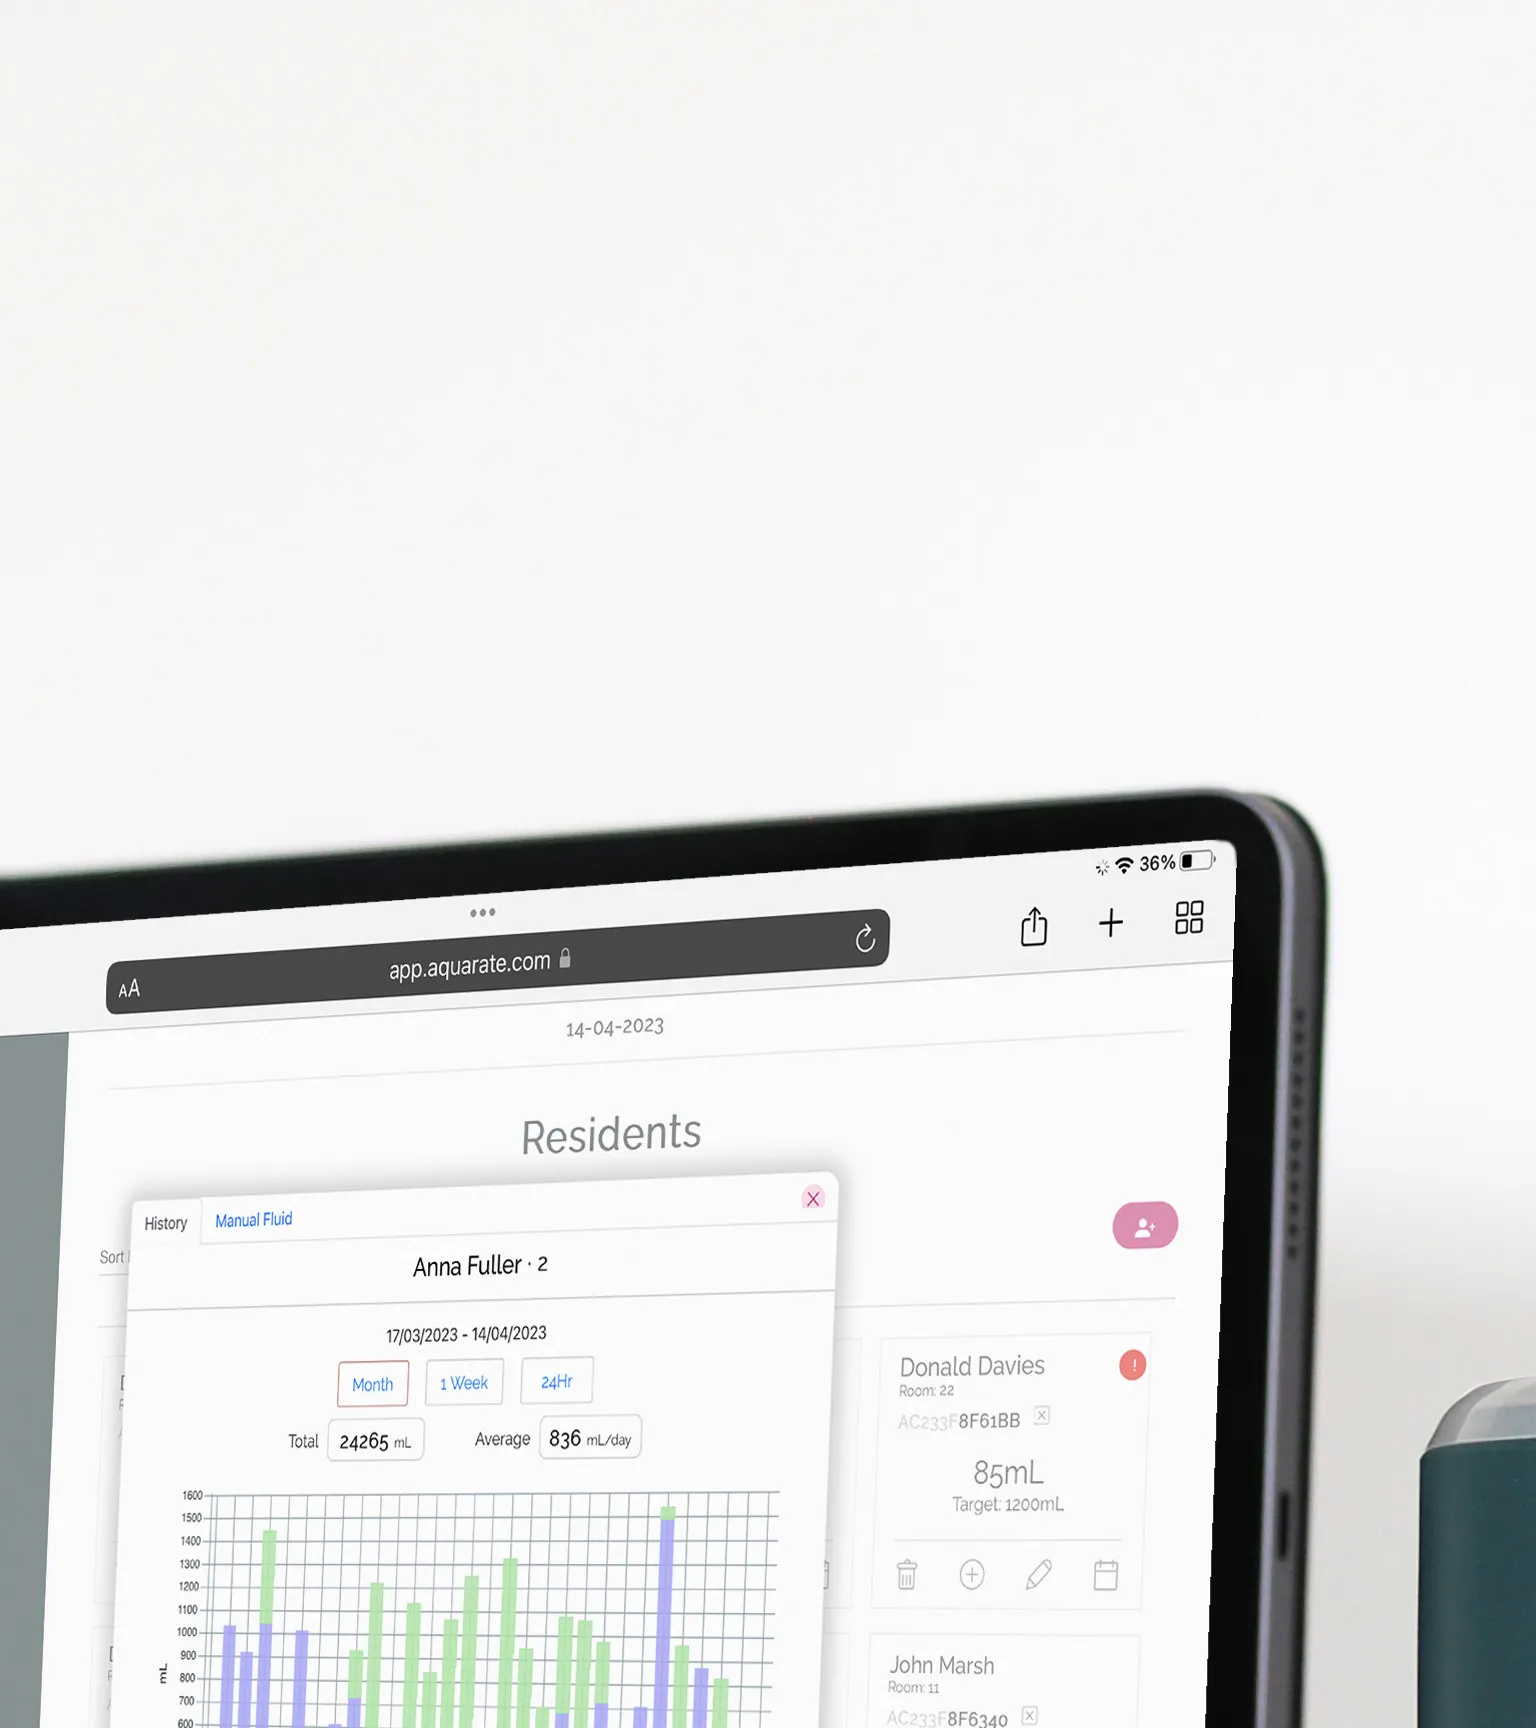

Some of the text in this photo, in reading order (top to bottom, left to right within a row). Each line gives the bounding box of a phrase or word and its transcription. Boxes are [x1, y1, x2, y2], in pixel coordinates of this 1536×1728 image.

[1140, 854, 1176, 871] 36%
[390, 955, 550, 983] app.aquarate.com
[567, 1018, 663, 1038] 14-04-2023
[523, 1114, 700, 1154] Residents
[145, 1211, 292, 1232] History Manual Fluid
[100, 1250, 124, 1263] Sort
[413, 1257, 461, 1277] Anna
[468, 1254, 522, 1275] Fuller
[538, 1256, 547, 1271] 2
[387, 1327, 458, 1346] 17/03/2023
[472, 1325, 546, 1344] 14/04/2023
[901, 1355, 1044, 1377] Donald Davies
[353, 1377, 393, 1392] Month
[451, 1375, 488, 1390] Week
[542, 1374, 572, 1390] 24Hr
[899, 1384, 954, 1397] Room: 22
[289, 1429, 631, 1452] Total 24265 mL Average 836 mL/day
[974, 1460, 1044, 1489] 85mL
[183, 1490, 203, 1500] 1600
[953, 1496, 1064, 1515] Target: 1200mL
[182, 1513, 202, 1522] 1500
[182, 1536, 201, 1546] 1400
[180, 1559, 200, 1569] 1300
[180, 1581, 199, 1591] 1200
[179, 1605, 198, 1614] 1100
[178, 1627, 200, 1637] 1000
[181, 1650, 196, 1660] 900
[890, 1656, 994, 1674] John Marsh
[159, 1663, 167, 1684] mL
[180, 1673, 195, 1682] 800
[888, 1681, 940, 1694] Room: 11
[179, 1696, 194, 1705] 700
[178, 1719, 193, 1728] 600
